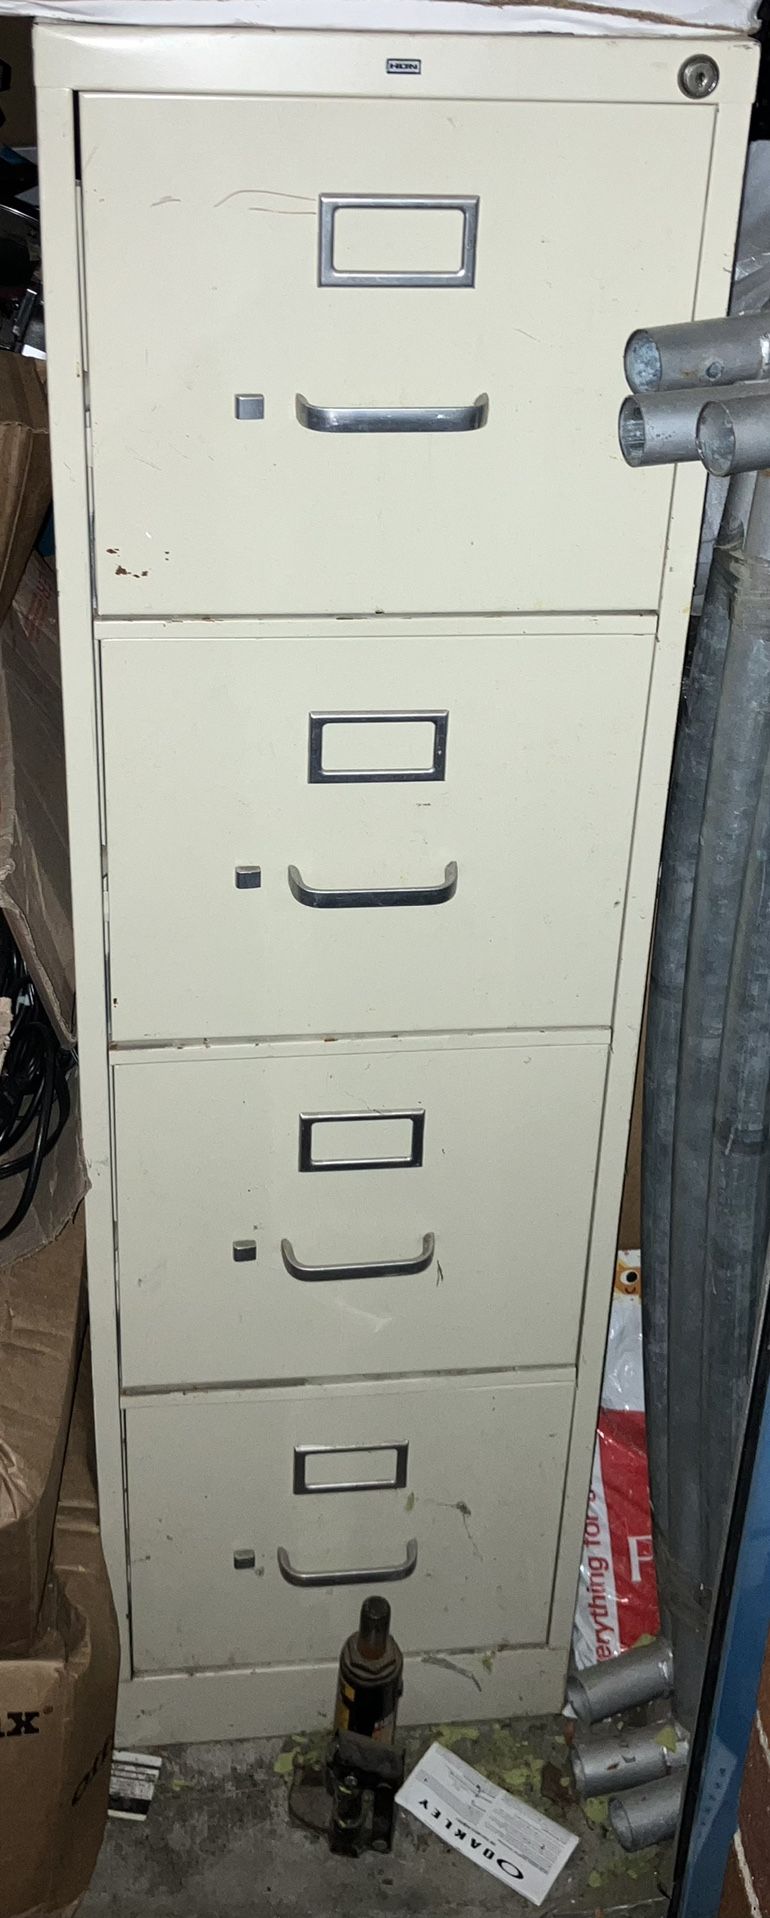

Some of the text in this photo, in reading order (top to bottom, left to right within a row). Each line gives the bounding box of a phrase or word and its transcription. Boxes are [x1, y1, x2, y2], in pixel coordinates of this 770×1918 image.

[587, 1556, 614, 1660] erything
[0, 1711, 40, 1738] x
[418, 1797, 496, 1861] OAKLEY
